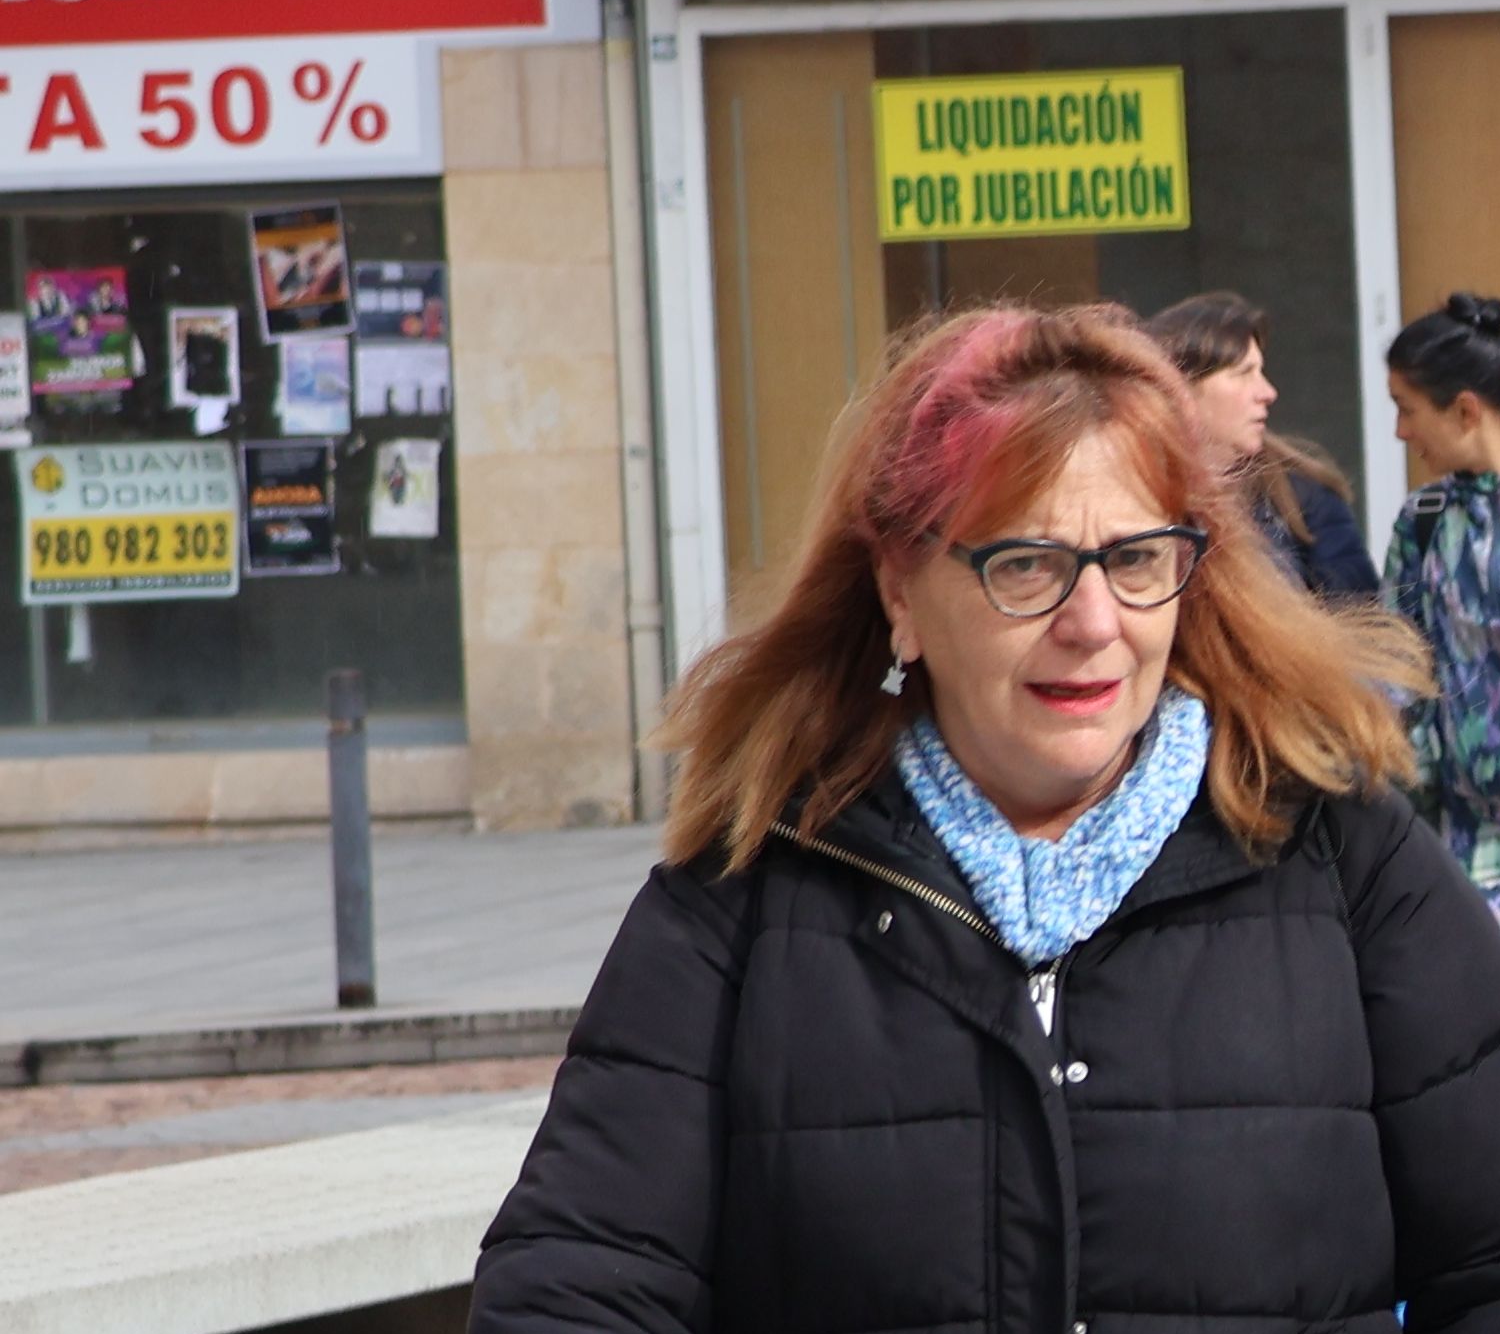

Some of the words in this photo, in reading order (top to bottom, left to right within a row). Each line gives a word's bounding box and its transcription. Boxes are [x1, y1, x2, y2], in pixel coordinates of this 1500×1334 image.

[917, 78, 1142, 156] LIQUIDACIÓN
[892, 174, 961, 227] POR
[973, 155, 1174, 222] JUBILACIÓN
[78, 448, 226, 477] SUAVIS
[81, 480, 229, 510] DOMUS
[35, 528, 91, 568] 980
[105, 525, 160, 565] 982
[173, 522, 228, 561] 303
